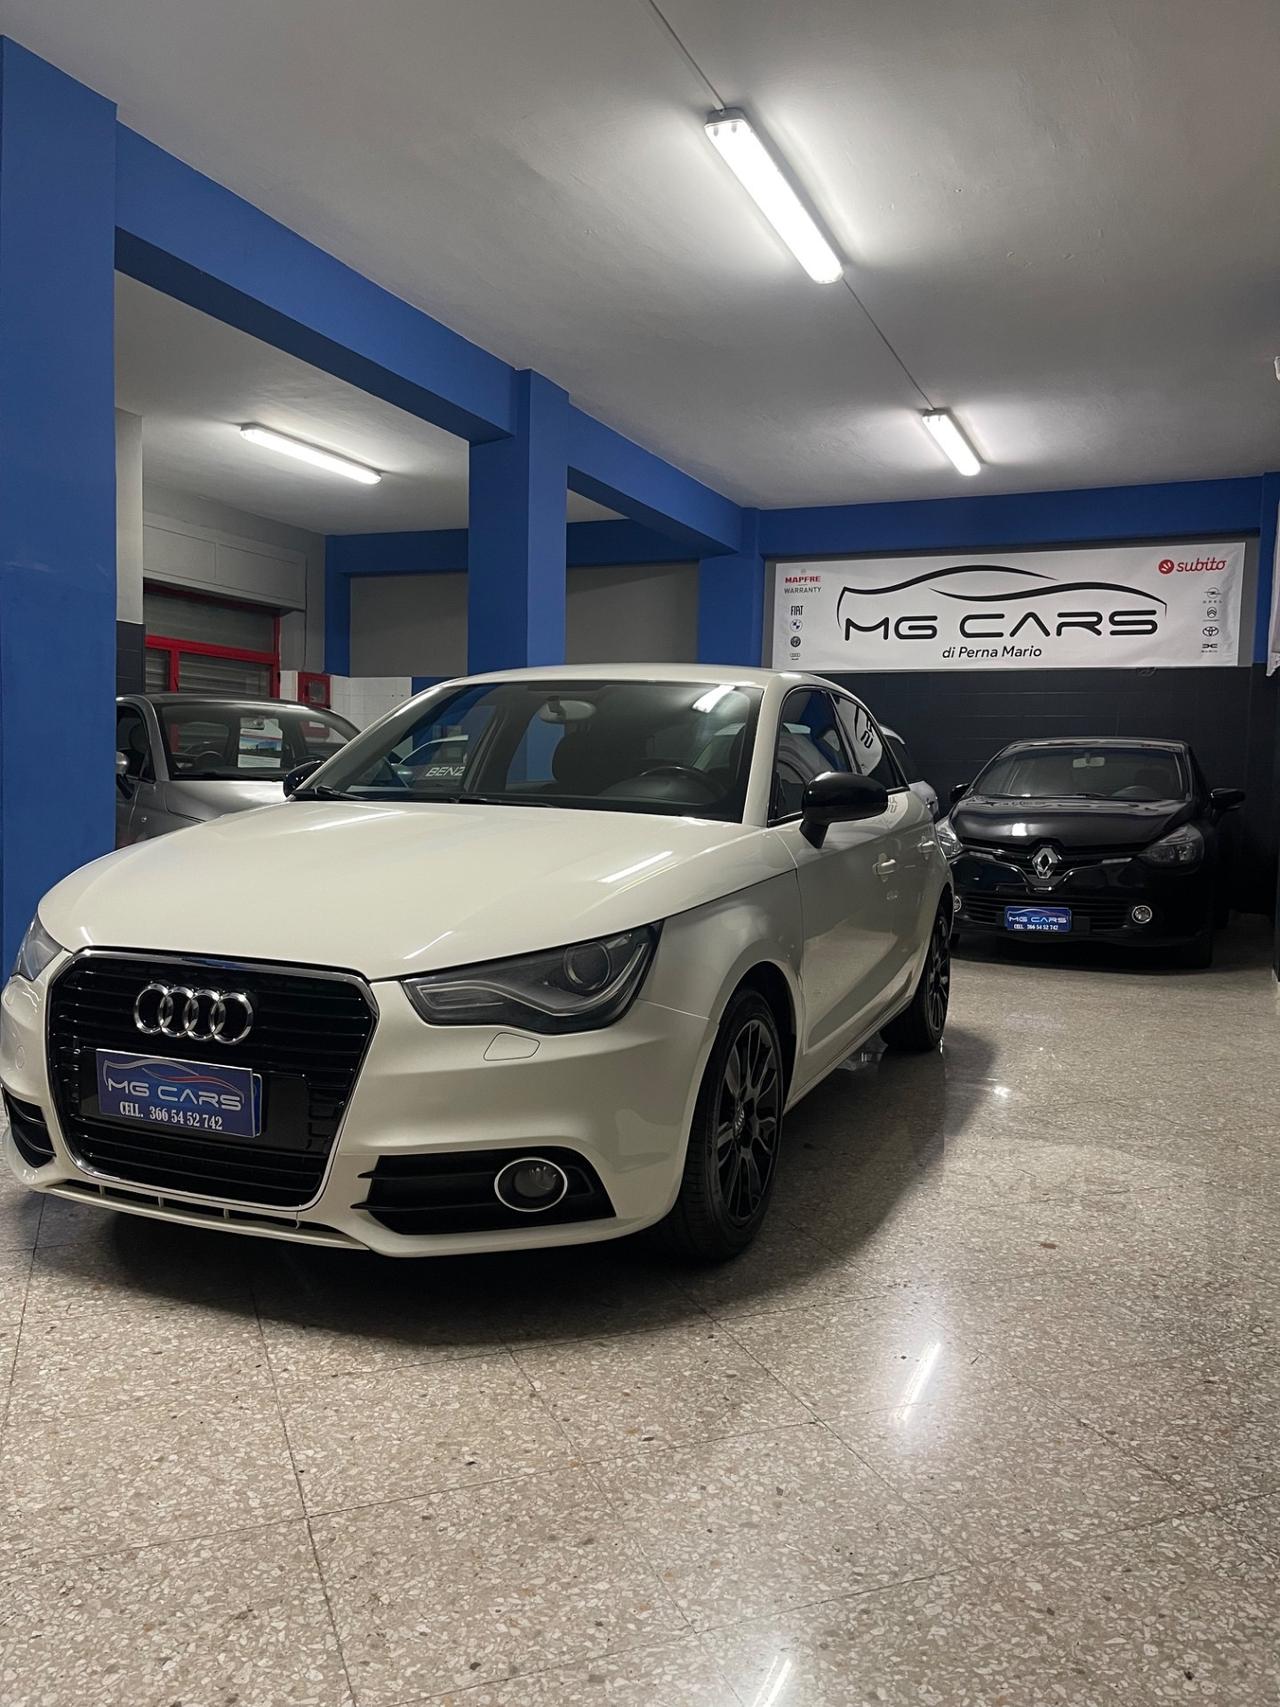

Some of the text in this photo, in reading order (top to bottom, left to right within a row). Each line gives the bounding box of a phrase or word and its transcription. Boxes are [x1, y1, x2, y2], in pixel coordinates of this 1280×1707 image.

[1176, 557, 1227, 572] subito
[790, 605, 804, 616] FIAT
[845, 608, 1158, 641] MG CARS
[942, 644, 1042, 659] di Perna Mario
[108, 1078, 242, 1111] MG CARS
[119, 1101, 223, 1130] CELL. 366 54 52 742
